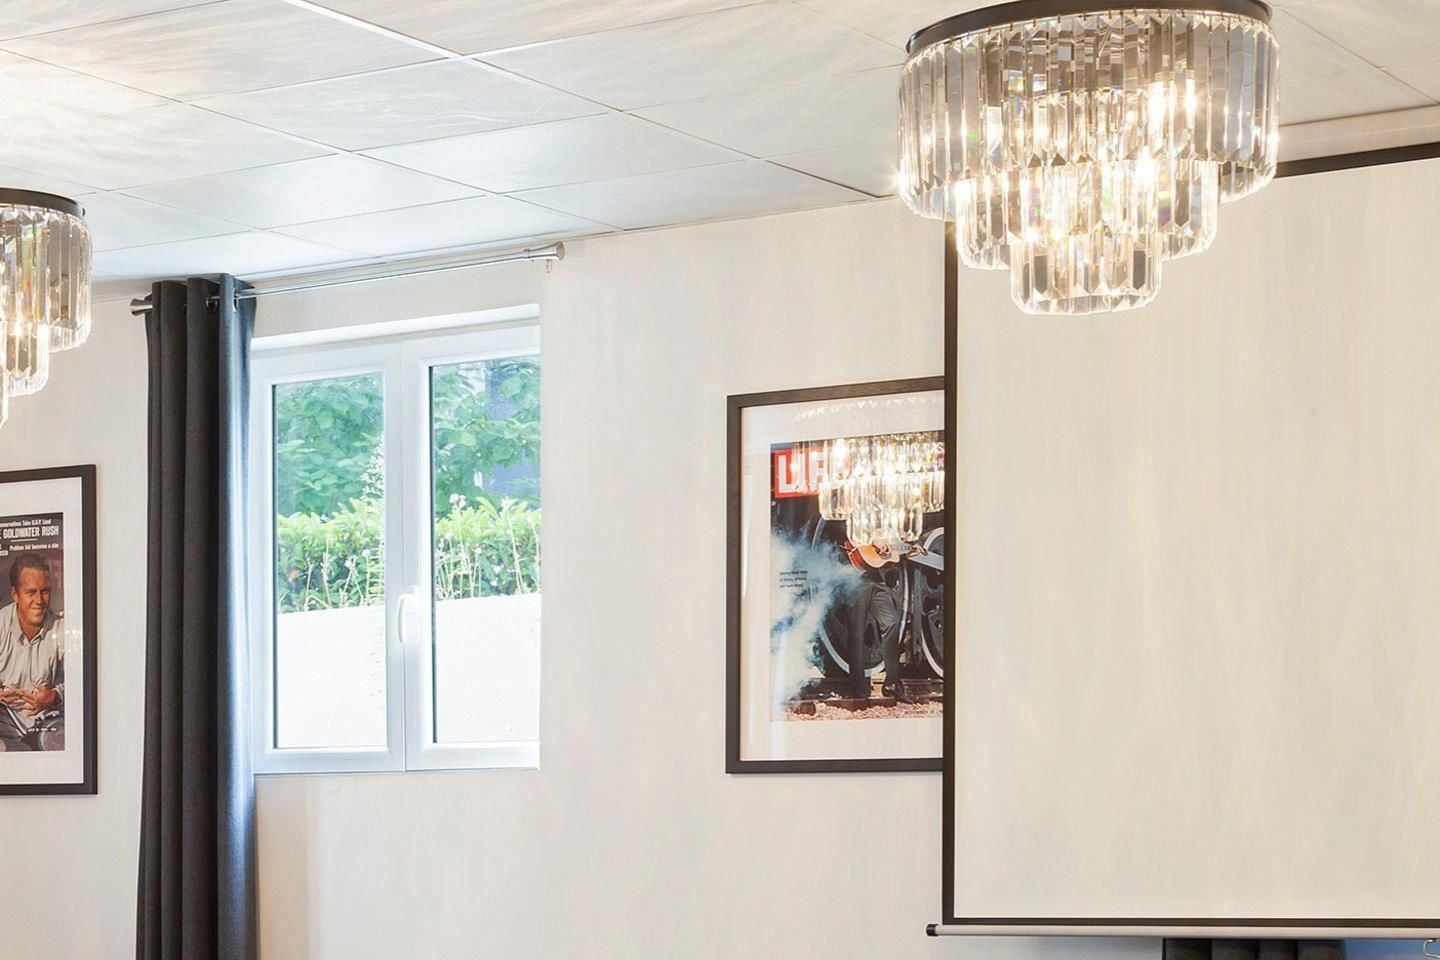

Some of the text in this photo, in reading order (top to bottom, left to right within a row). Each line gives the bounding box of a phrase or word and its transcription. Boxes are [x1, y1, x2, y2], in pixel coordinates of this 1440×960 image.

[778, 450, 838, 493] LIF
[3, 526, 40, 539] GOLDWATER
[41, 525, 59, 537] RUSH
